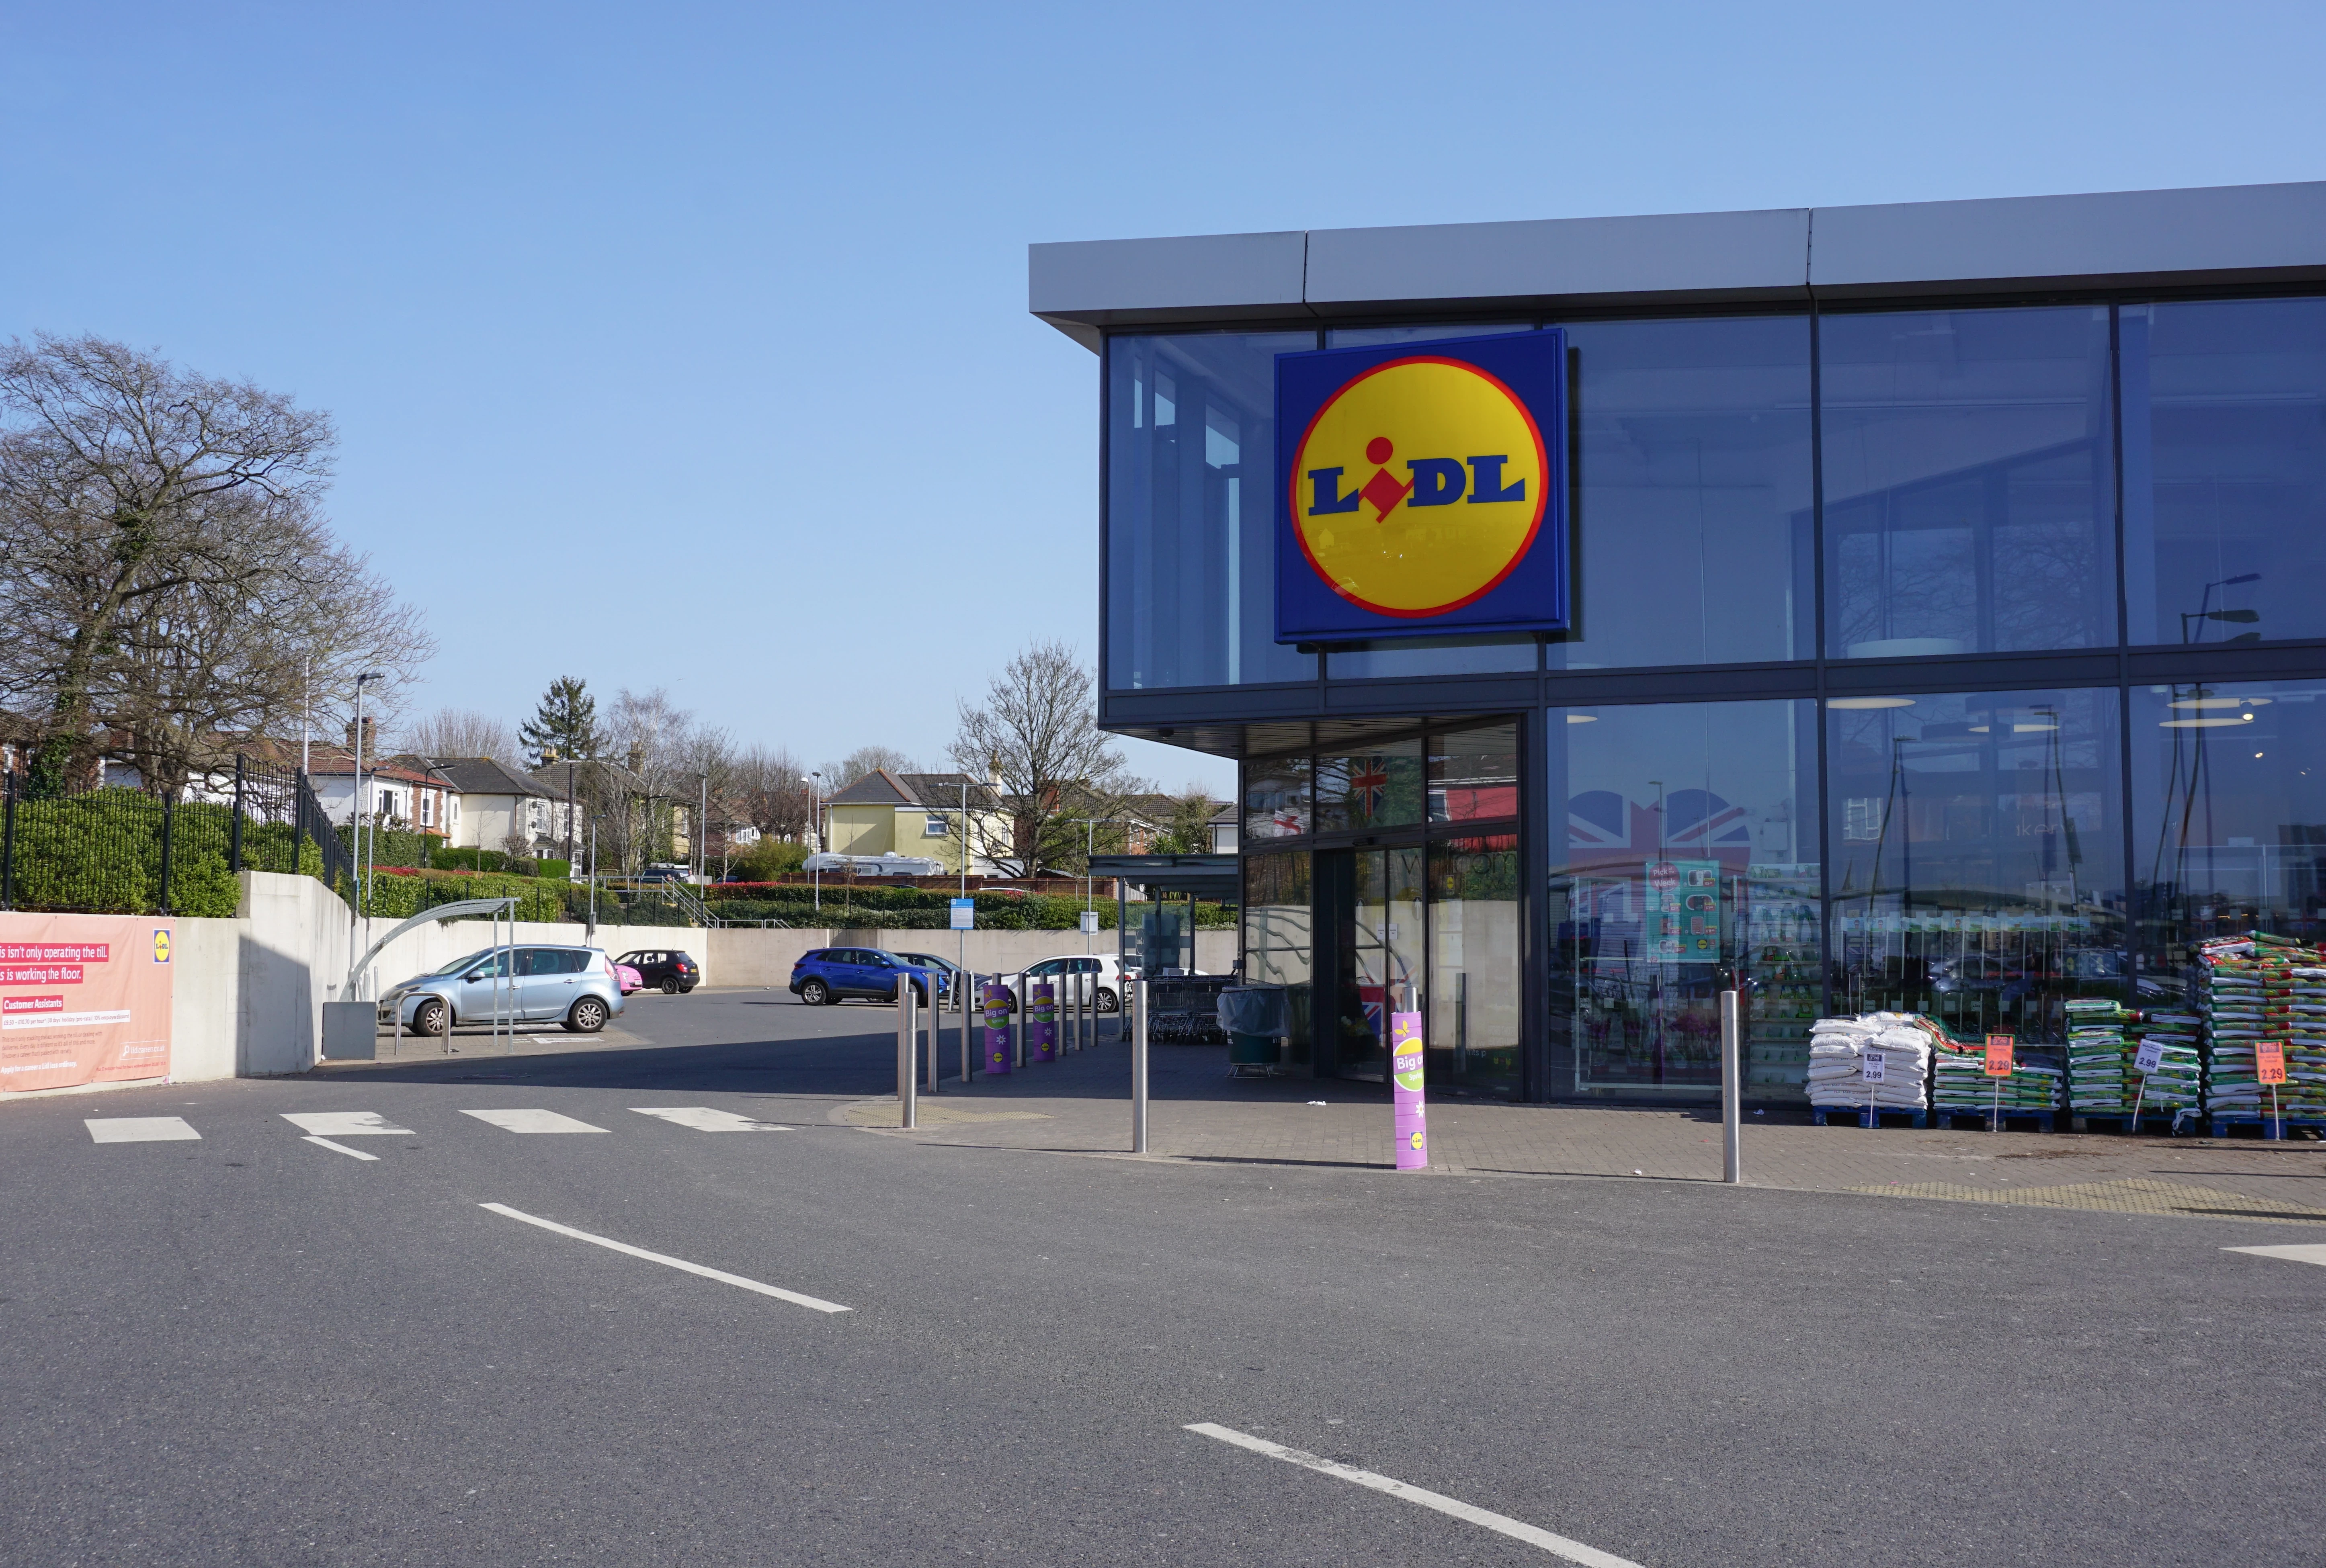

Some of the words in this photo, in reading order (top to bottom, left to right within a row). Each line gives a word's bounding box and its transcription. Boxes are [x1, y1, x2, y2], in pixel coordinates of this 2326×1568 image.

[1653, 868, 1668, 876] Pick
[1654, 878, 1676, 887] Week
[8, 946, 25, 958] isn't
[26, 945, 42, 961] only
[44, 946, 81, 961] operating
[82, 946, 94, 958] the
[96, 946, 107, 958] till.
[0, 969, 4, 981] s
[7, 968, 13, 981] is
[15, 968, 46, 983] working
[48, 967, 59, 980] the
[61, 967, 81, 980] floor.
[4, 1000, 34, 1009] Customer
[34, 999, 62, 1008] Assistants
[985, 1009, 996, 1017] Big
[1397, 1056, 1416, 1070] Big
[1988, 1060, 2009, 1071] 2.29
[2139, 1057, 2156, 1068] 2.99
[0, 1065, 14, 1074] Apply
[2262, 1068, 2283, 1080] 2.29
[1866, 1071, 1881, 1079] 2.99
